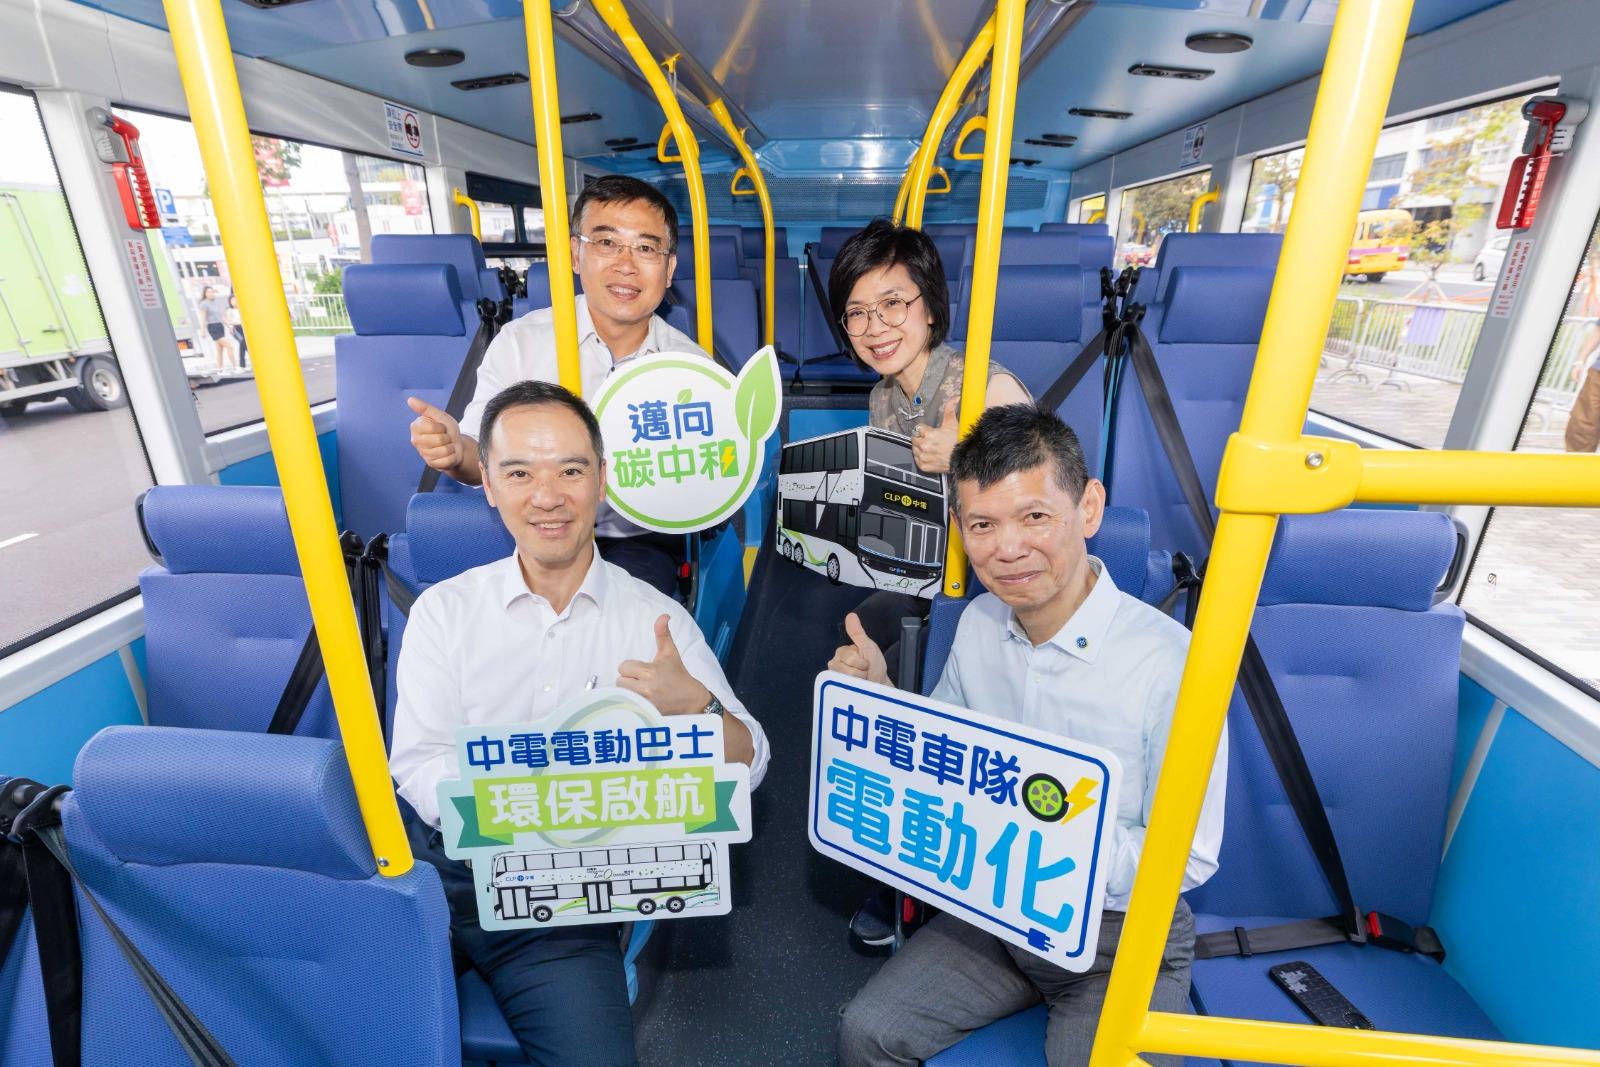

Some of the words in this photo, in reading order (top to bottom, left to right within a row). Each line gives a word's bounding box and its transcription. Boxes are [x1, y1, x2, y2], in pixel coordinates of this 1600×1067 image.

[157, 190, 172, 213] P
[627, 400, 713, 443] 邁向
[612, 439, 739, 488] 碳中和
[884, 492, 901, 501] CLP
[912, 499, 928, 510] 中電
[466, 724, 714, 771] 中電電動巴士
[831, 704, 1022, 807] 中電車隊
[488, 772, 704, 828] 環保啟航
[827, 758, 1076, 933] 電動化
